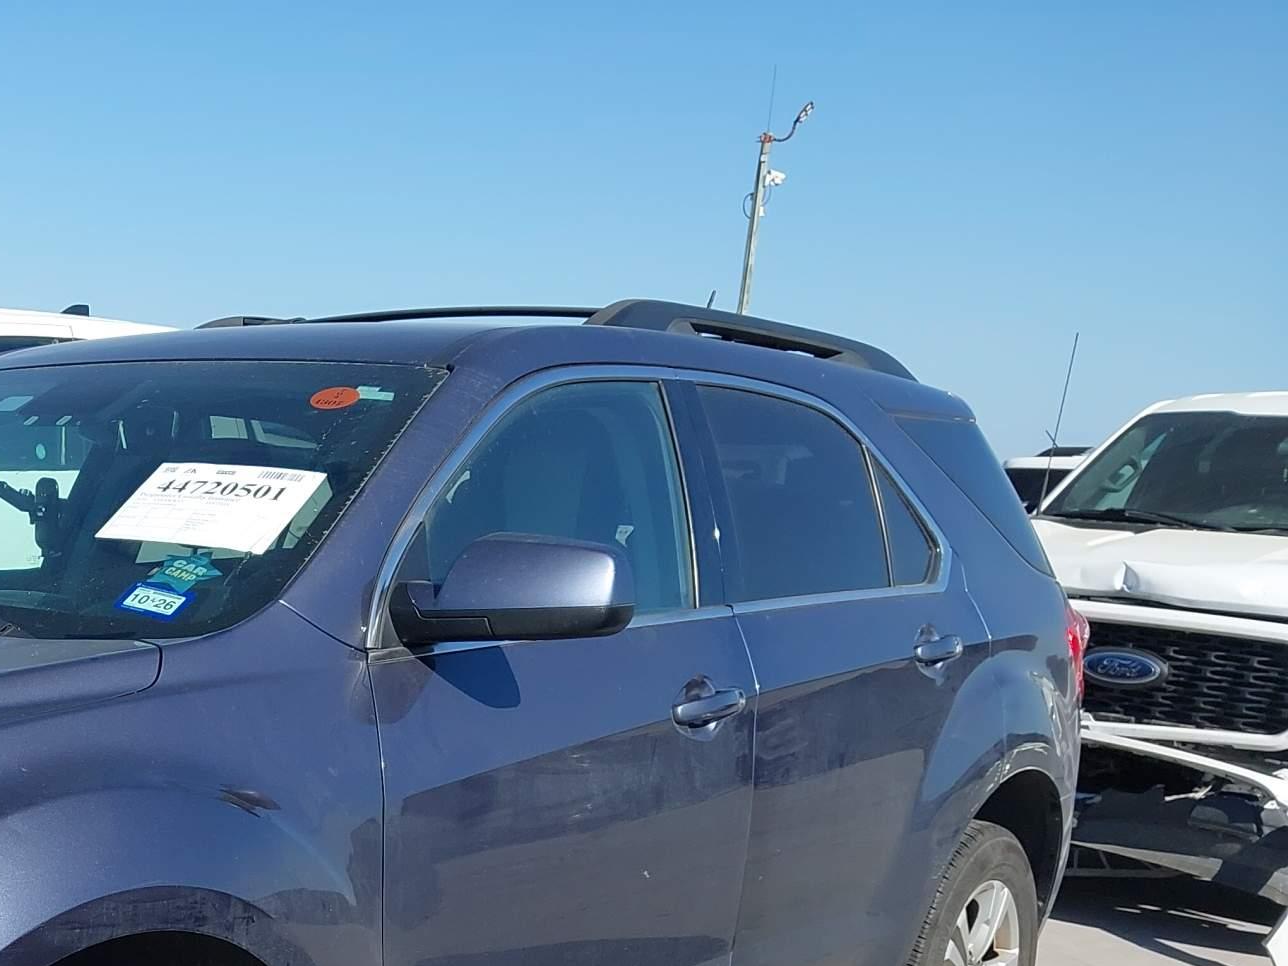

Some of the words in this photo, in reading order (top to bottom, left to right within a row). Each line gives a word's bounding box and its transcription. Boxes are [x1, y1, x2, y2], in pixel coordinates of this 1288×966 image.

[156, 479, 287, 501] 44720501
[164, 567, 196, 581] CAMP
[173, 560, 208, 576] CAR
[130, 593, 150, 605] 10
[152, 598, 177, 611] 26
[1097, 658, 1142, 678] Ford
